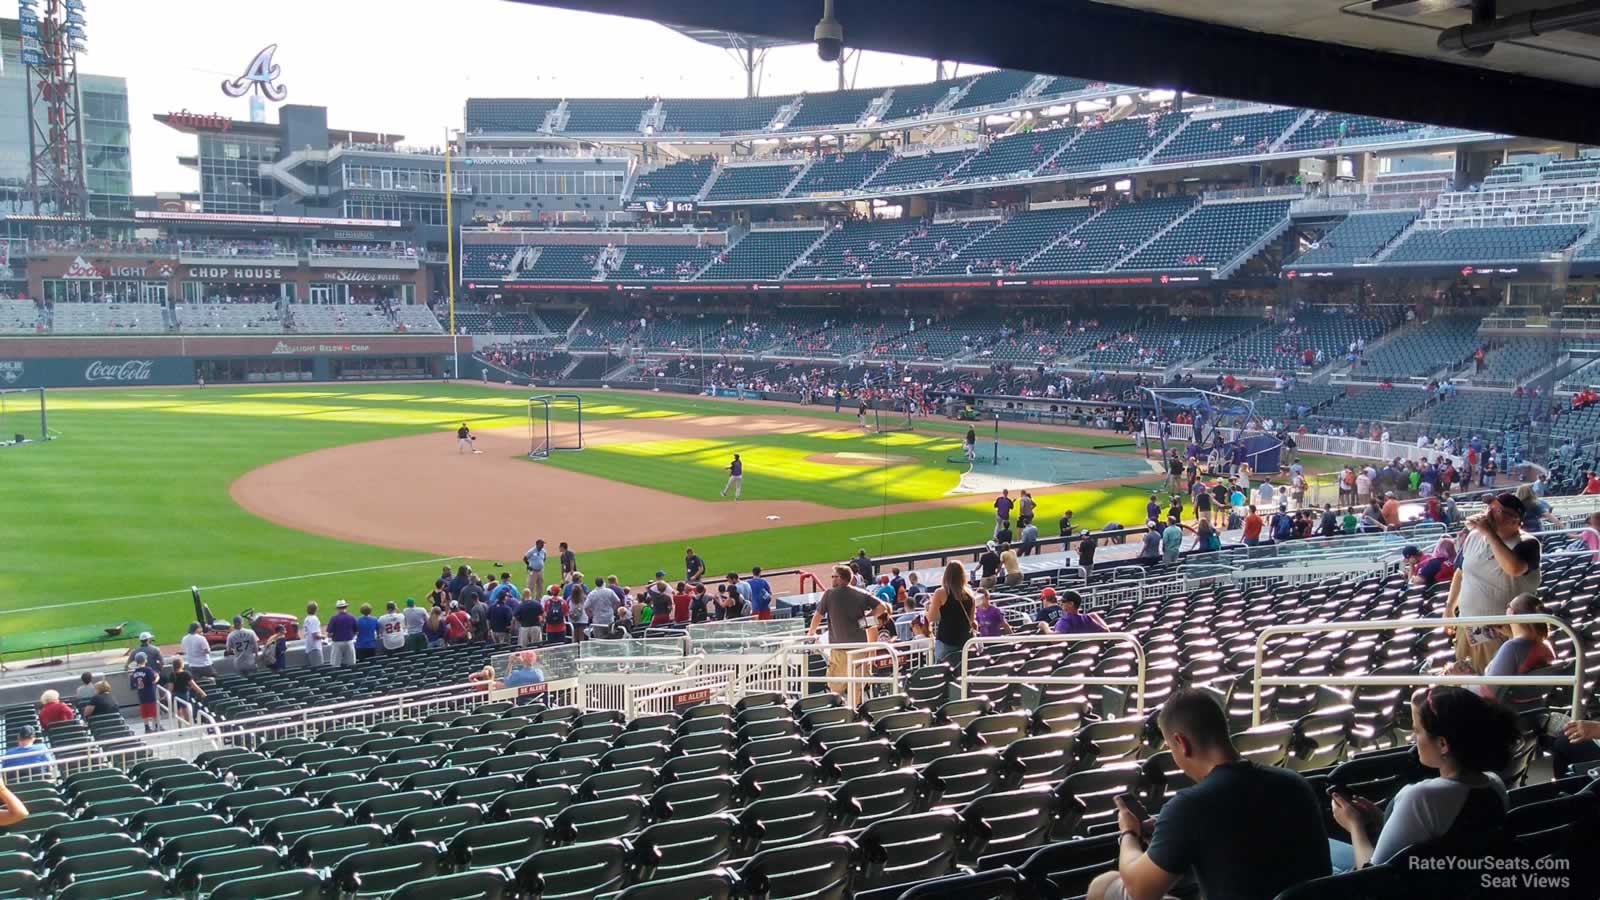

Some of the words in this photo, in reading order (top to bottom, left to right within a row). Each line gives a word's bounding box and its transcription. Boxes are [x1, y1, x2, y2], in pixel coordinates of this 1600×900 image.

[168, 108, 232, 131] xfinity
[677, 203, 693, 211] 6:12
[110, 266, 147, 277] LIGHT
[189, 268, 229, 278] CHOP
[234, 269, 282, 279] HOUSE
[336, 270, 377, 281] Silver
[385, 621, 401, 634] 24
[235, 640, 250, 652] 27
[520, 687, 529, 695] BE
[529, 684, 546, 693] ALERT
[678, 695, 688, 703] BE
[687, 690, 707, 700] ALERT
